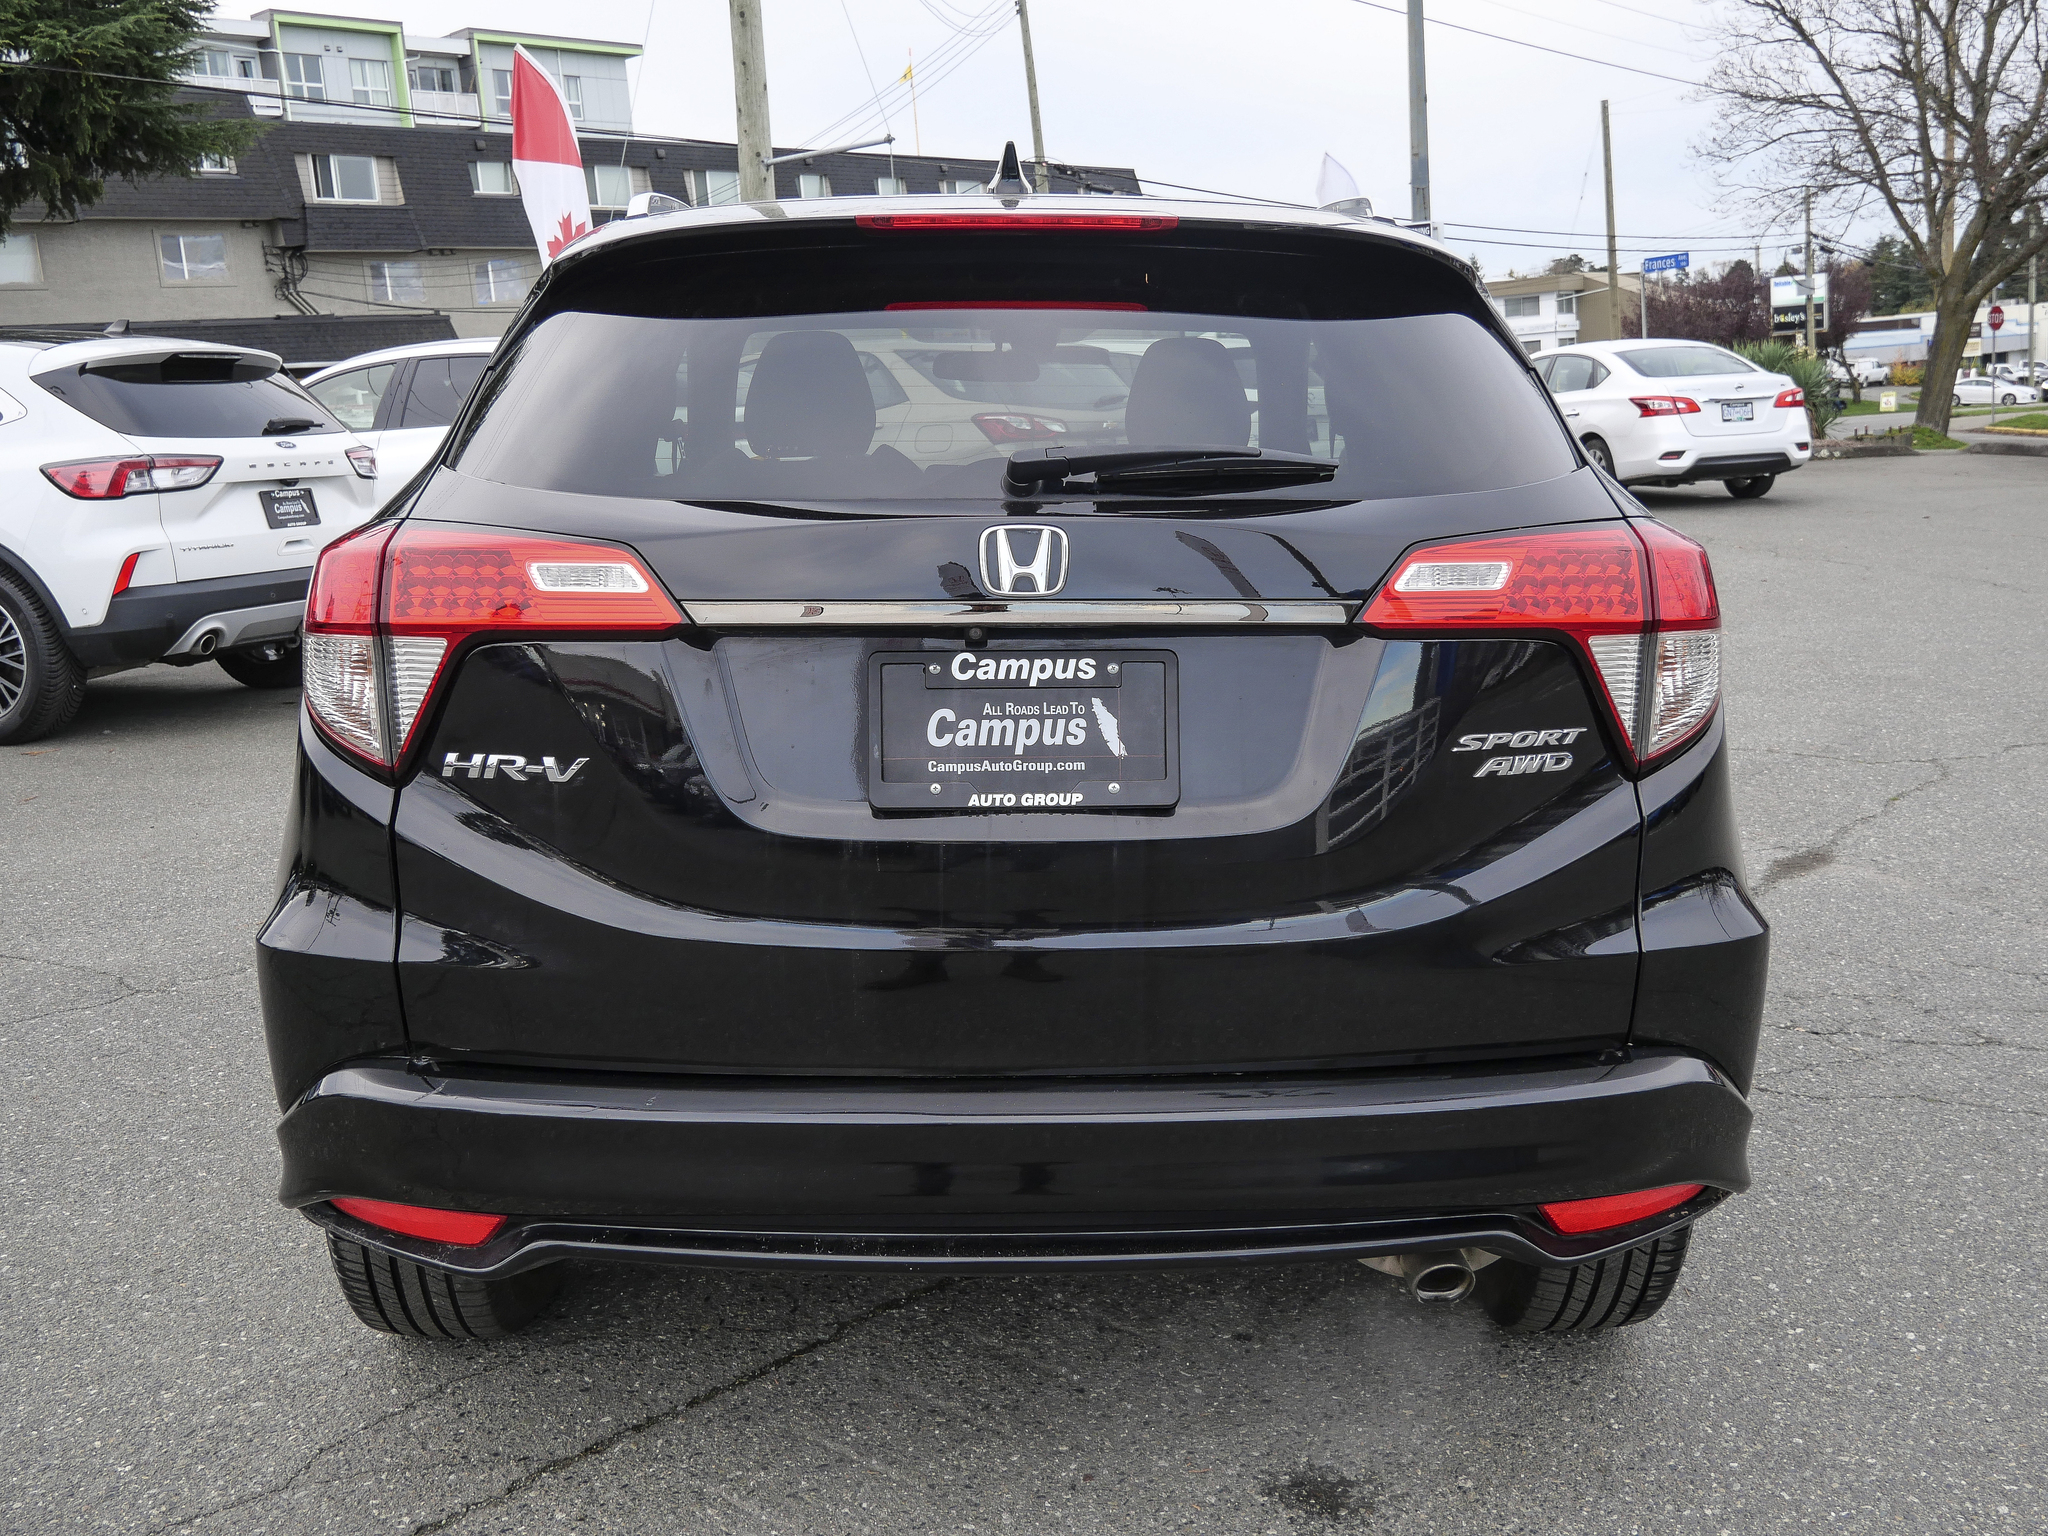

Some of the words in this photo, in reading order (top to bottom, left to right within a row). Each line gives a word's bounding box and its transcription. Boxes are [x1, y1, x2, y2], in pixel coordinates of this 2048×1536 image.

[1645, 258, 1675, 270] Frances
[1988, 314, 2003, 323] STOP
[275, 490, 300, 498] Campus
[274, 503, 302, 514] Campus
[951, 652, 1097, 687] Campus
[927, 708, 1087, 755] Campus
[1451, 727, 1588, 752] SPORT
[441, 752, 590, 782] HR-V
[928, 760, 1086, 774] CampusAutoGroup.com
[1473, 752, 1573, 778] AWD
[968, 794, 1016, 807] AUTO
[1021, 793, 1084, 806] GROUP
